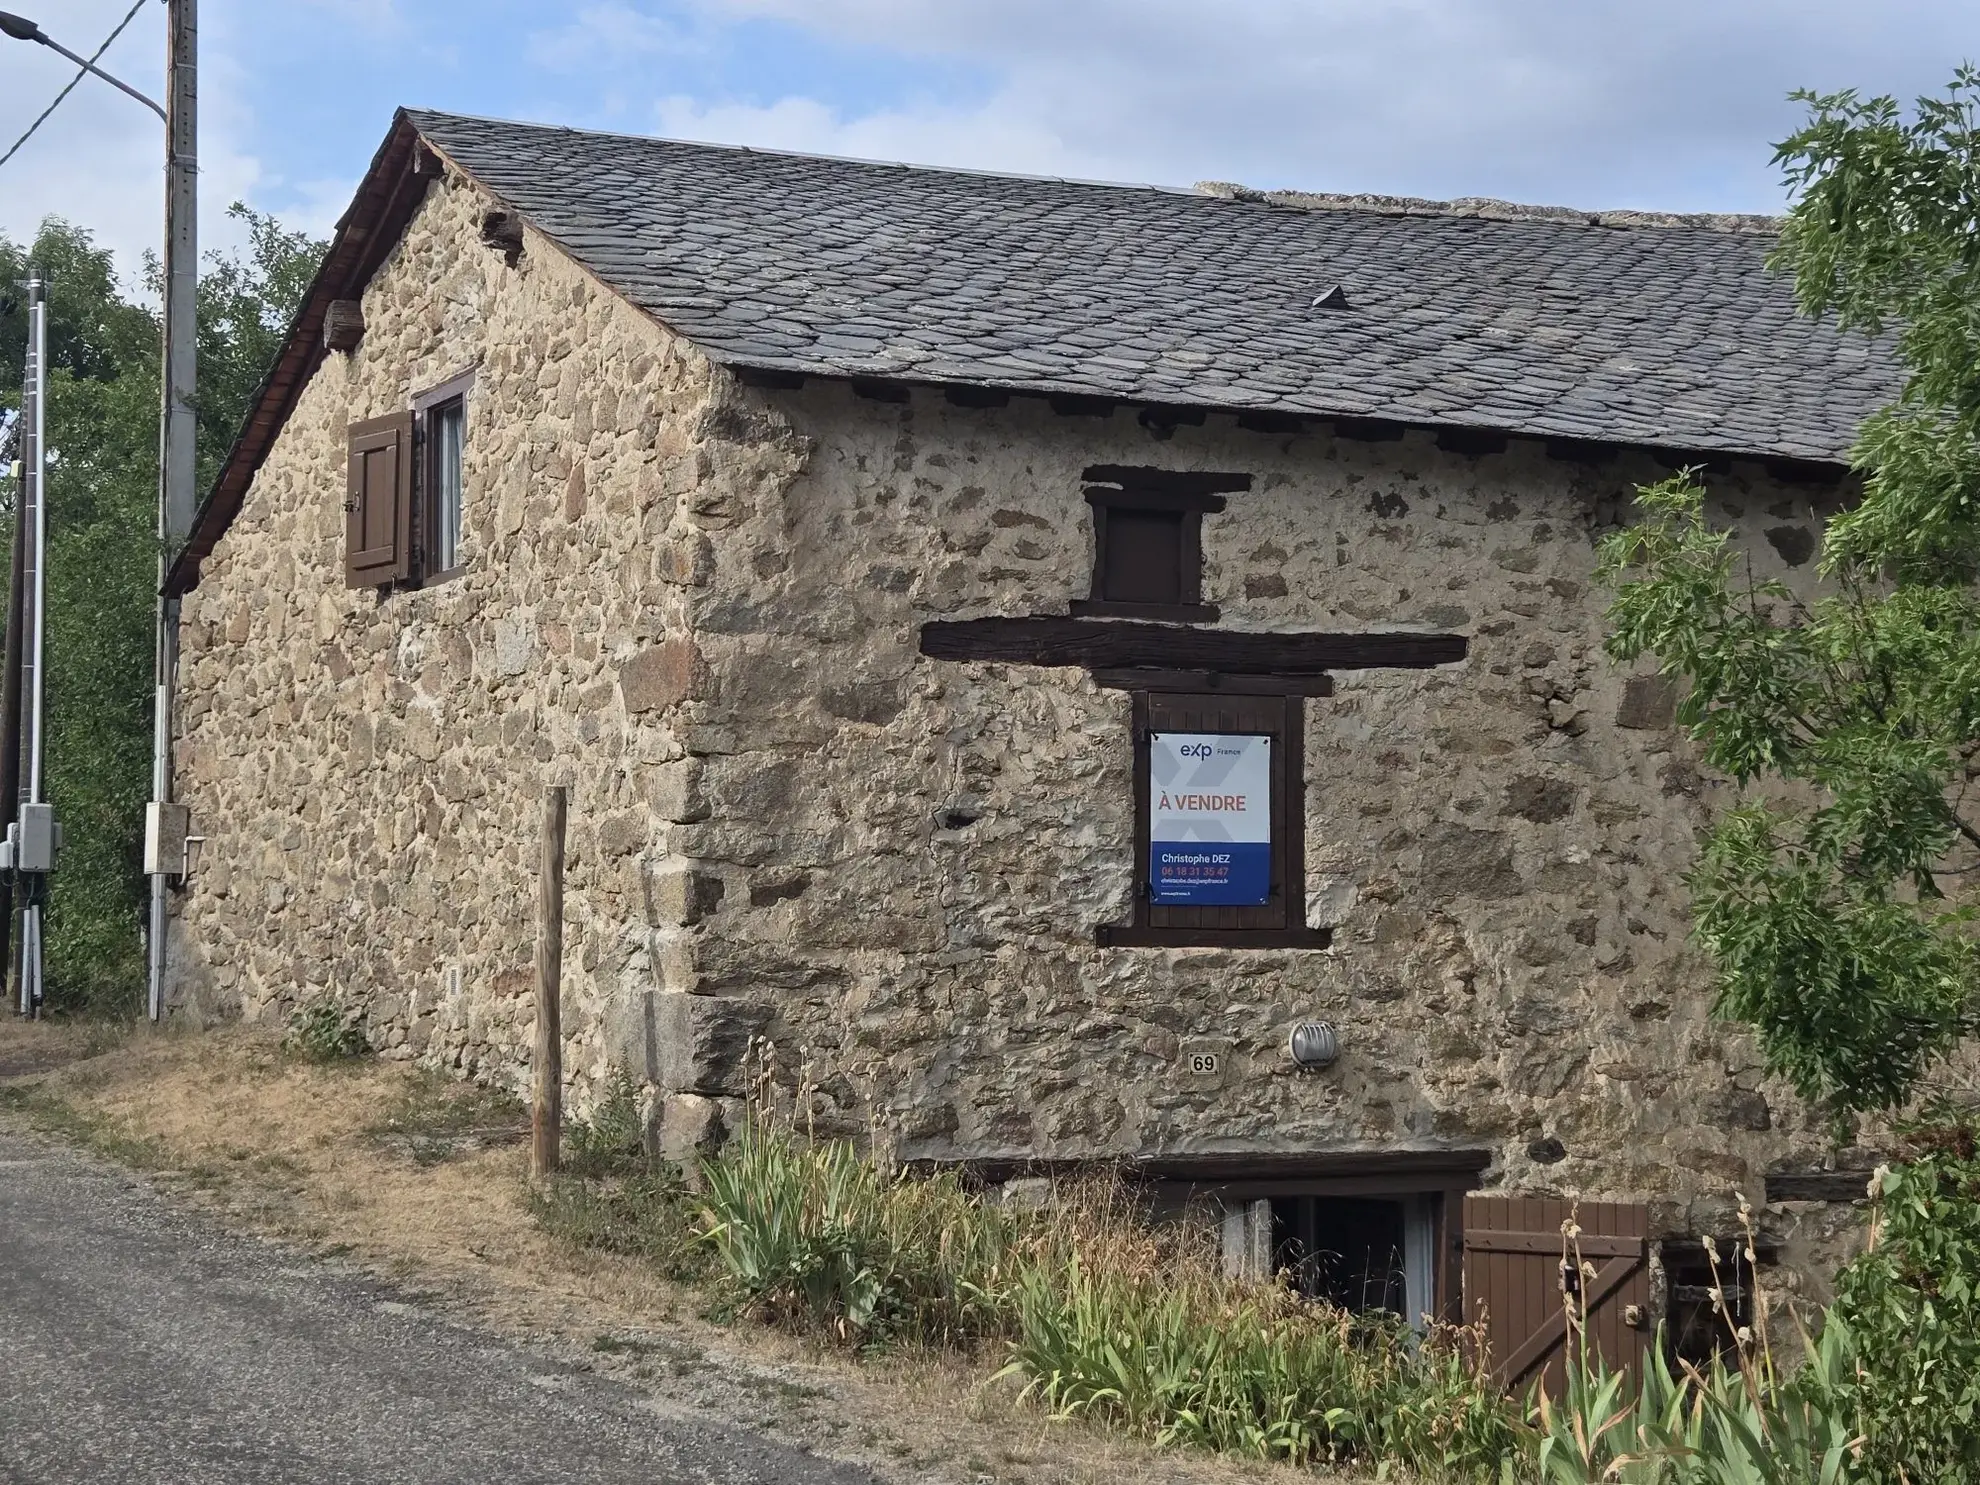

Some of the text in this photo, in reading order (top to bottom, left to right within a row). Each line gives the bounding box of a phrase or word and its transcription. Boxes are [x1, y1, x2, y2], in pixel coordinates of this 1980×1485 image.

[1159, 791, 1246, 811] À VENDRE
[1162, 853, 1230, 865] Christophe DEZ
[1162, 866, 1229, 876] 06 18 31 35 47
[1193, 1056, 1214, 1071] 69
